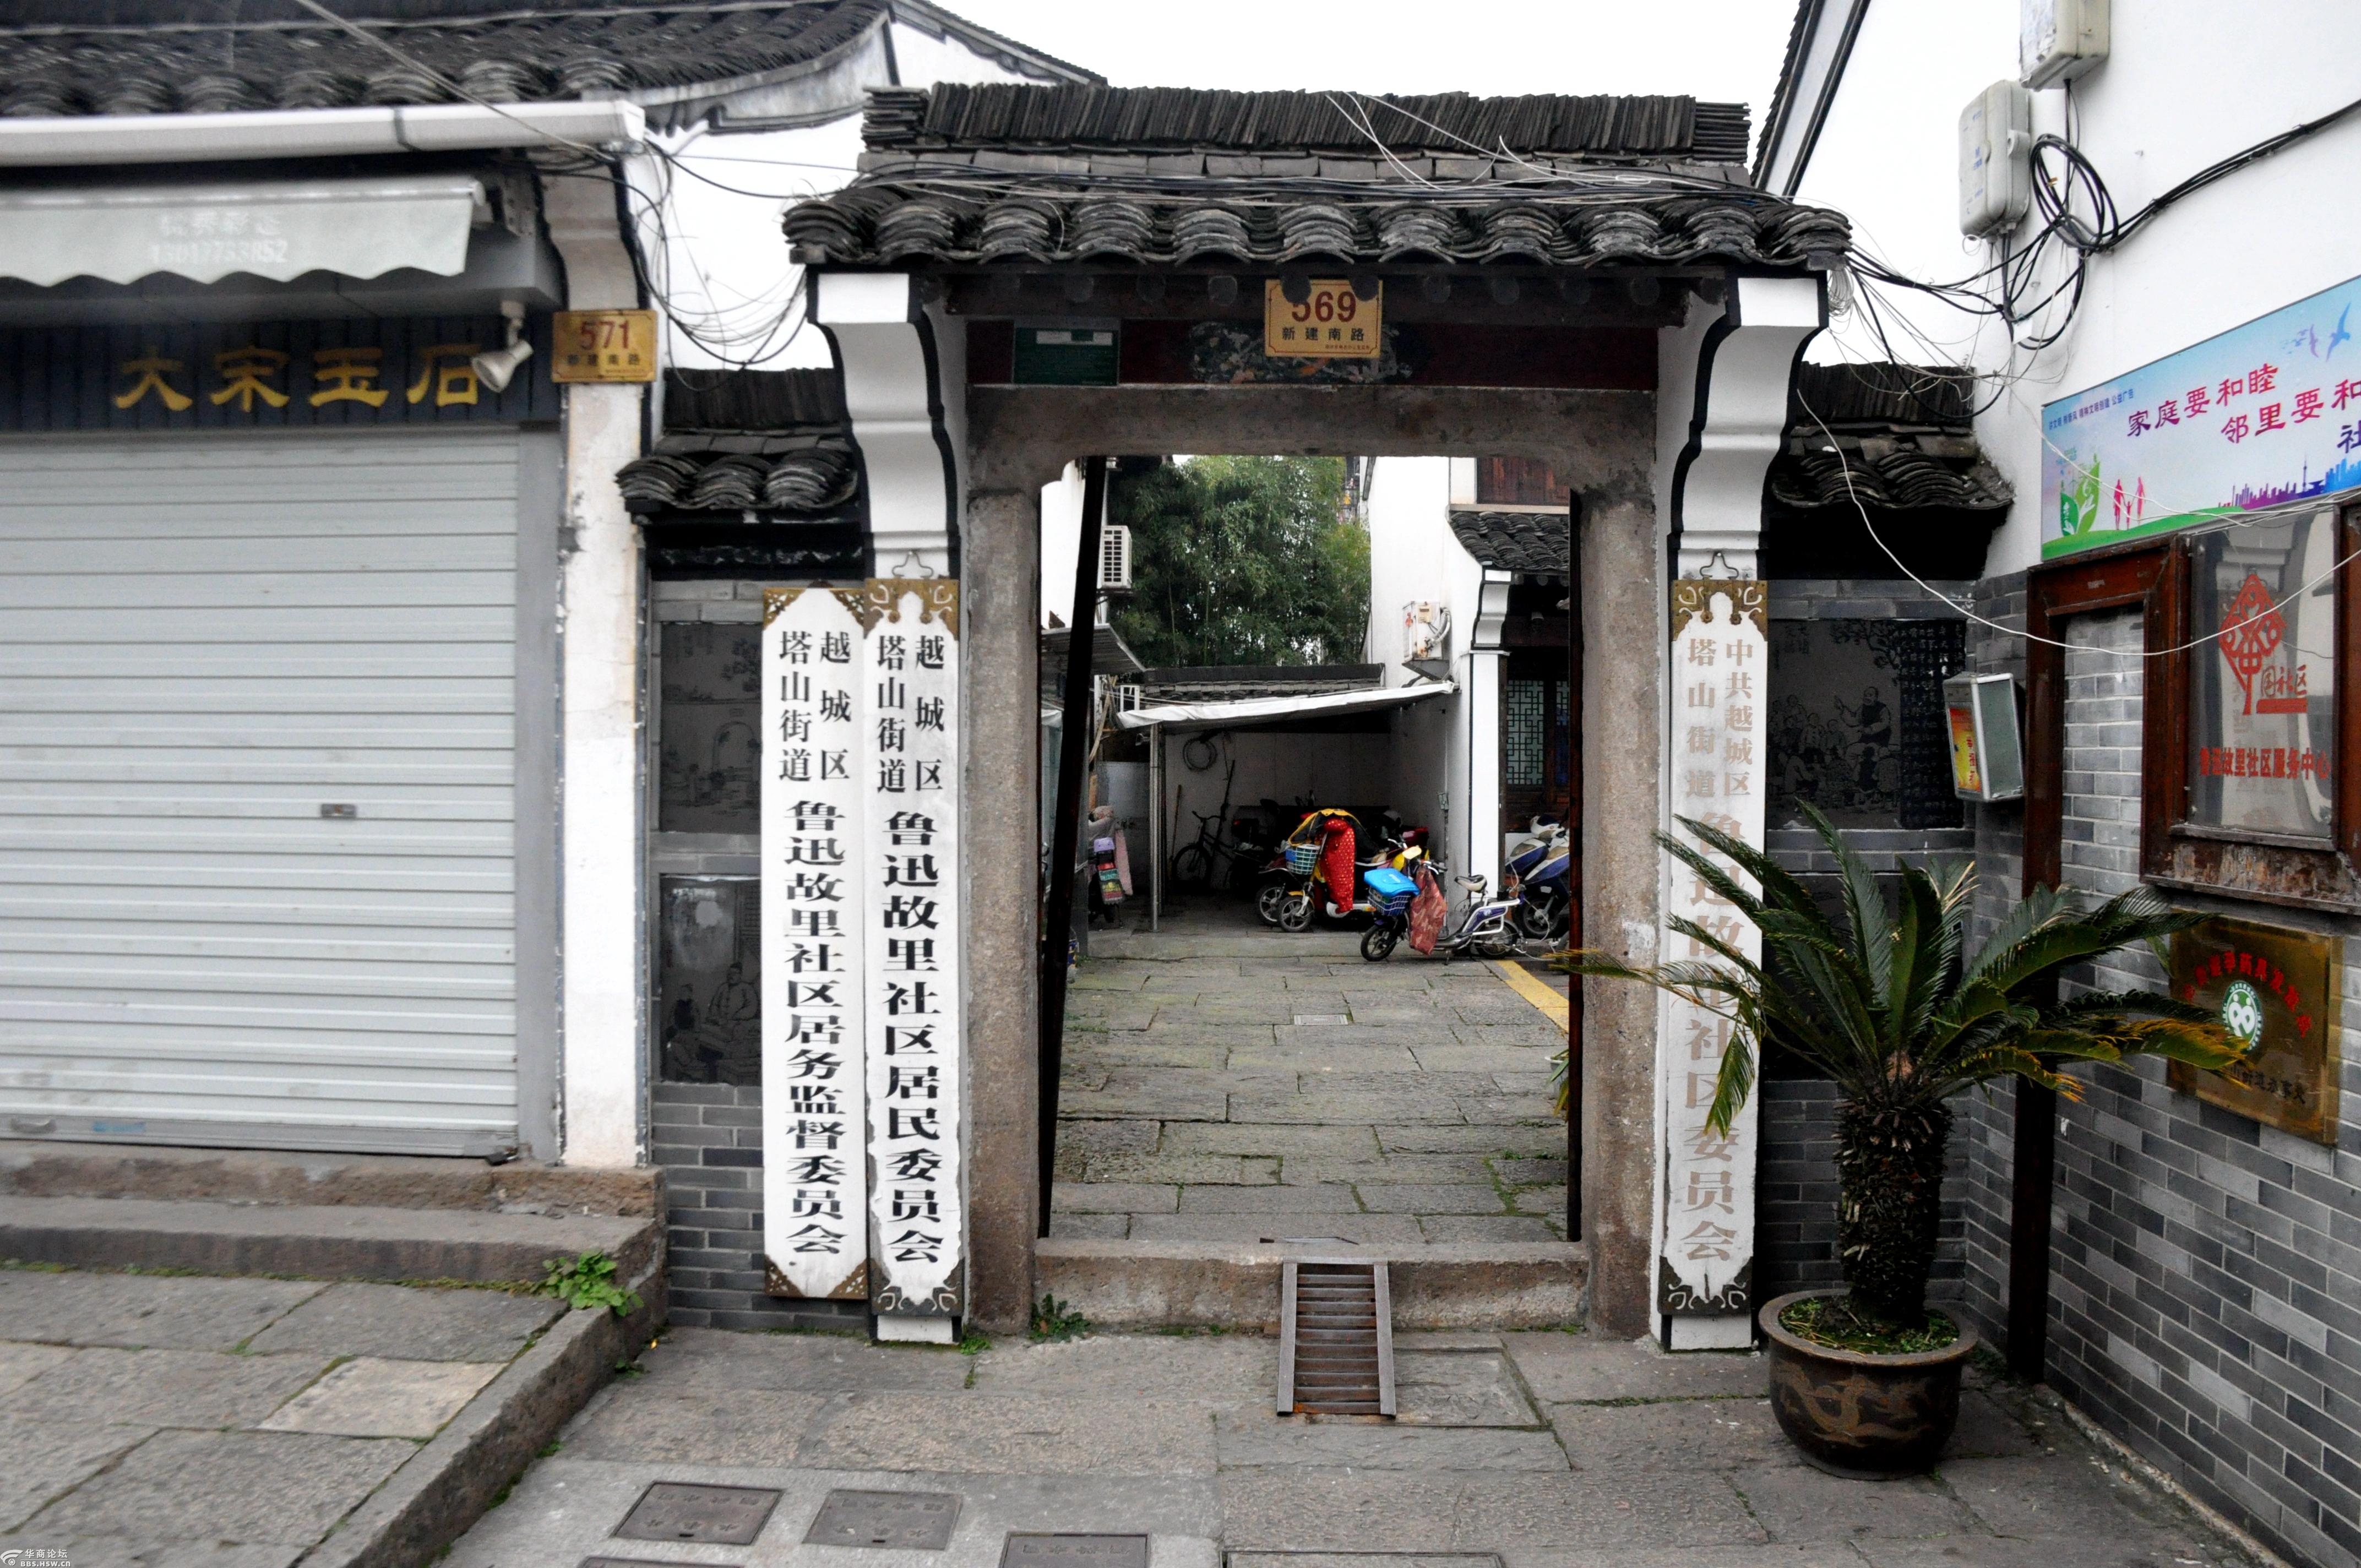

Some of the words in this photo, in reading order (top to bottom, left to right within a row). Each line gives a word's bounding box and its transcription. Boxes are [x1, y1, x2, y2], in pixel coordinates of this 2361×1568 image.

[113, 344, 482, 412] 大宋玉石
[580, 320, 630, 350] 571
[1281, 326, 1364, 341] 新建南路
[2126, 362, 2279, 437] 家庭要和睦
[779, 630, 812, 782] 塔山街道
[820, 631, 851, 781] 越城区
[877, 635, 906, 793] 塔山街道
[915, 635, 945, 792] 越城区
[1685, 638, 1717, 798] 塔山街道
[1723, 639, 1754, 797] 中共越城区
[784, 799, 848, 1255] 鲁迅故里社区居务监督委员会
[882, 810, 945, 1264] 鲁迅故里社区居民委员会
